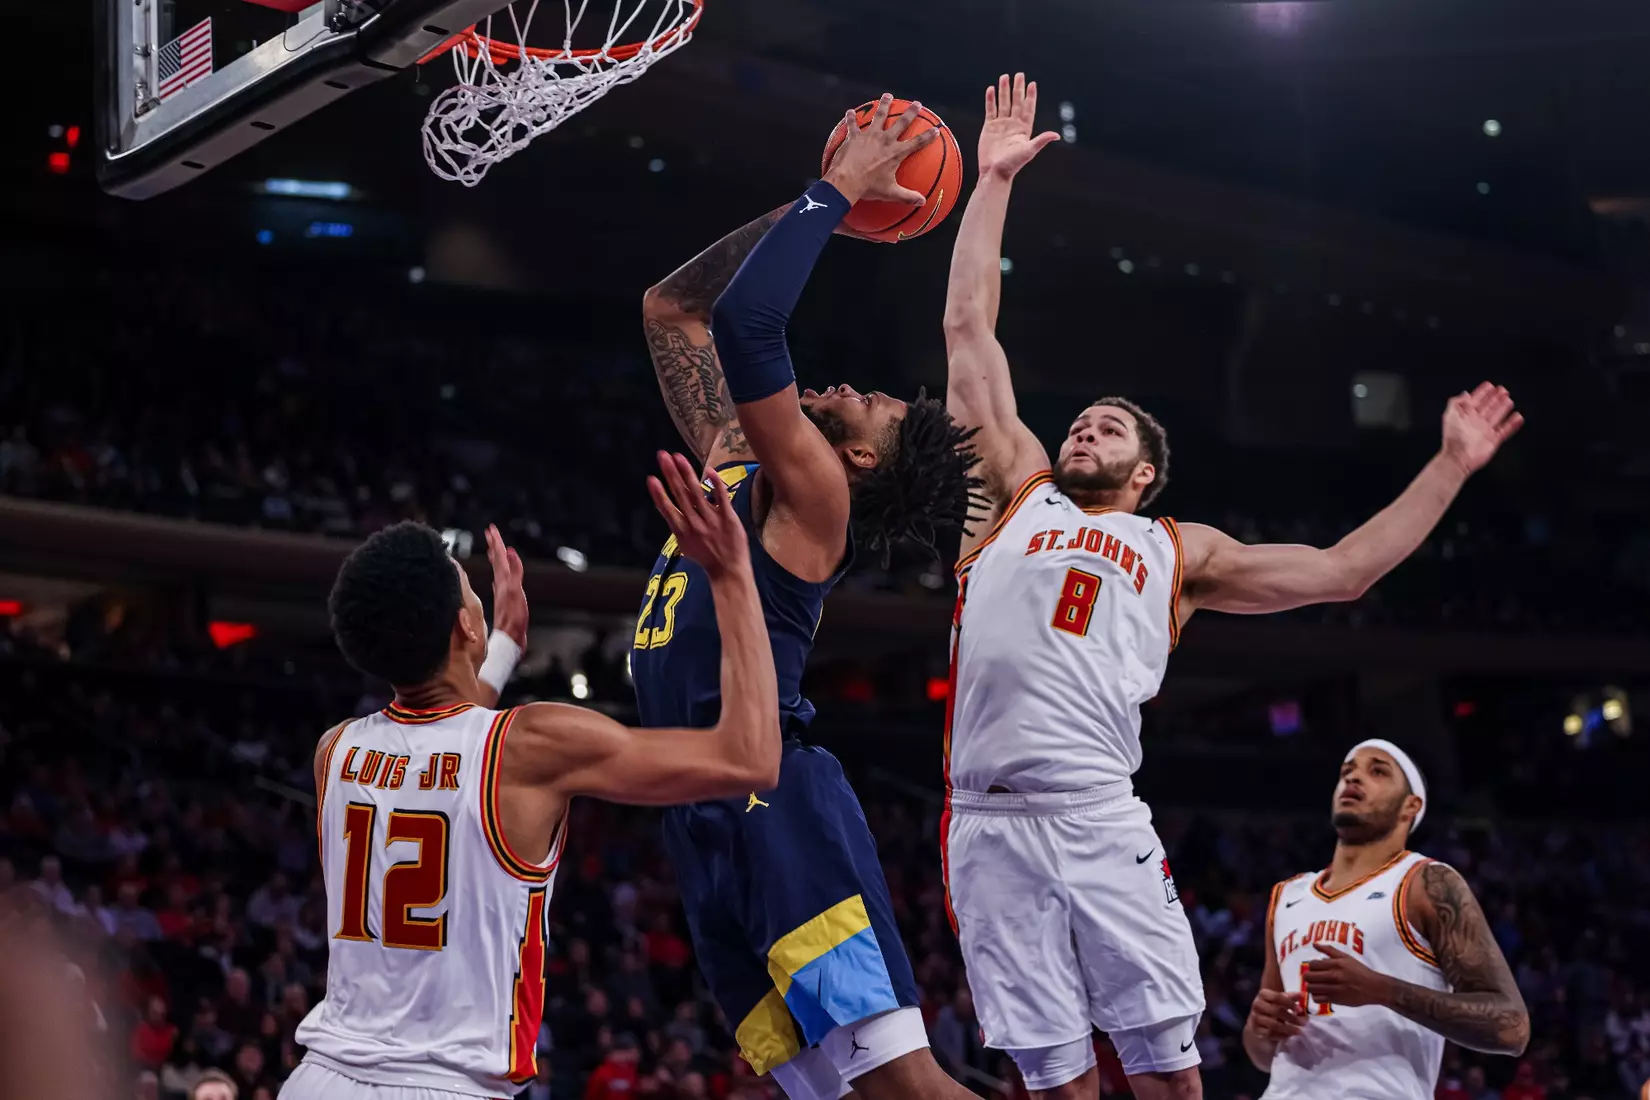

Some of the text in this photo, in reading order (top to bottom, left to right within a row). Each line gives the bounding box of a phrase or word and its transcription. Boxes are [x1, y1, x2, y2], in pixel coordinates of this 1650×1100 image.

[633, 571, 688, 649] 23
[1051, 566, 1102, 638] 8
[340, 746, 461, 790] LUIS JR
[333, 800, 450, 951] 12
[1301, 919, 1364, 956] JOHN'S
